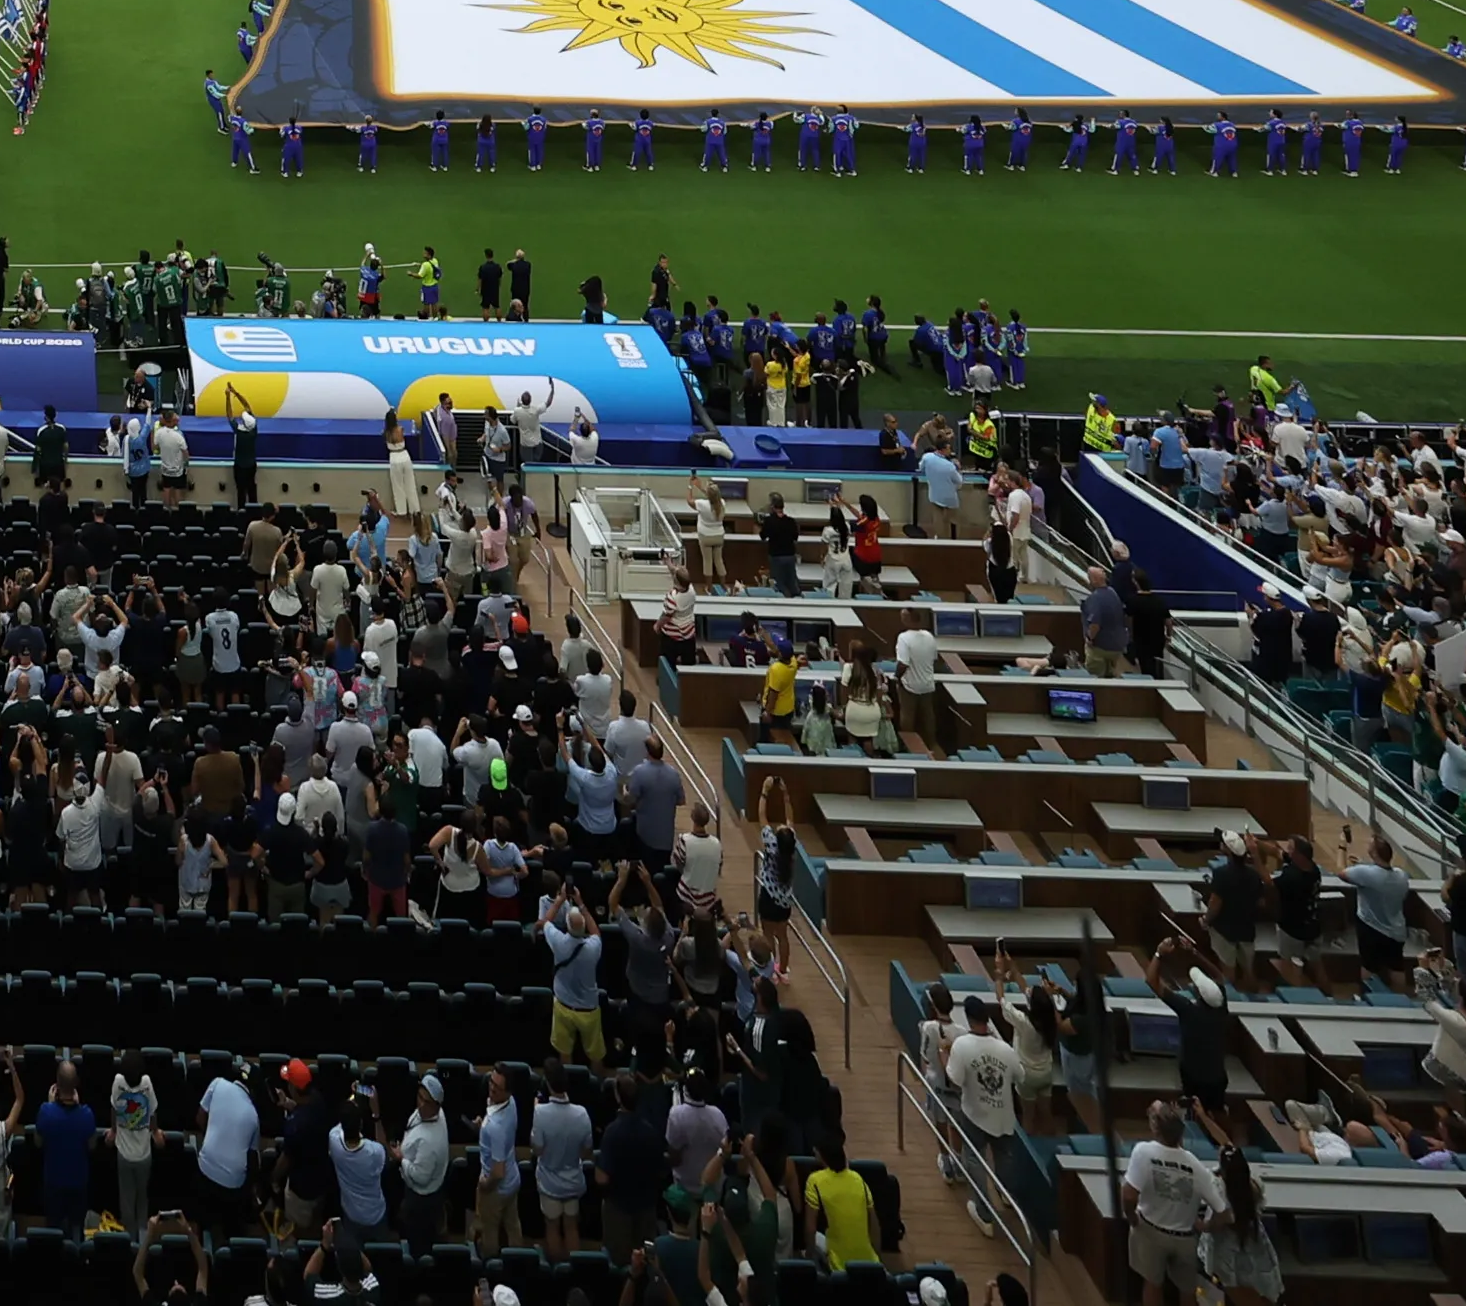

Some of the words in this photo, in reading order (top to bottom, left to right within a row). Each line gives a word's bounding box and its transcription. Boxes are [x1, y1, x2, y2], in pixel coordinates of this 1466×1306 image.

[23, 337, 45, 346] CUP
[45, 337, 82, 346] 2026
[362, 335, 536, 357] URUGUAY
[221, 627, 232, 650] 8
